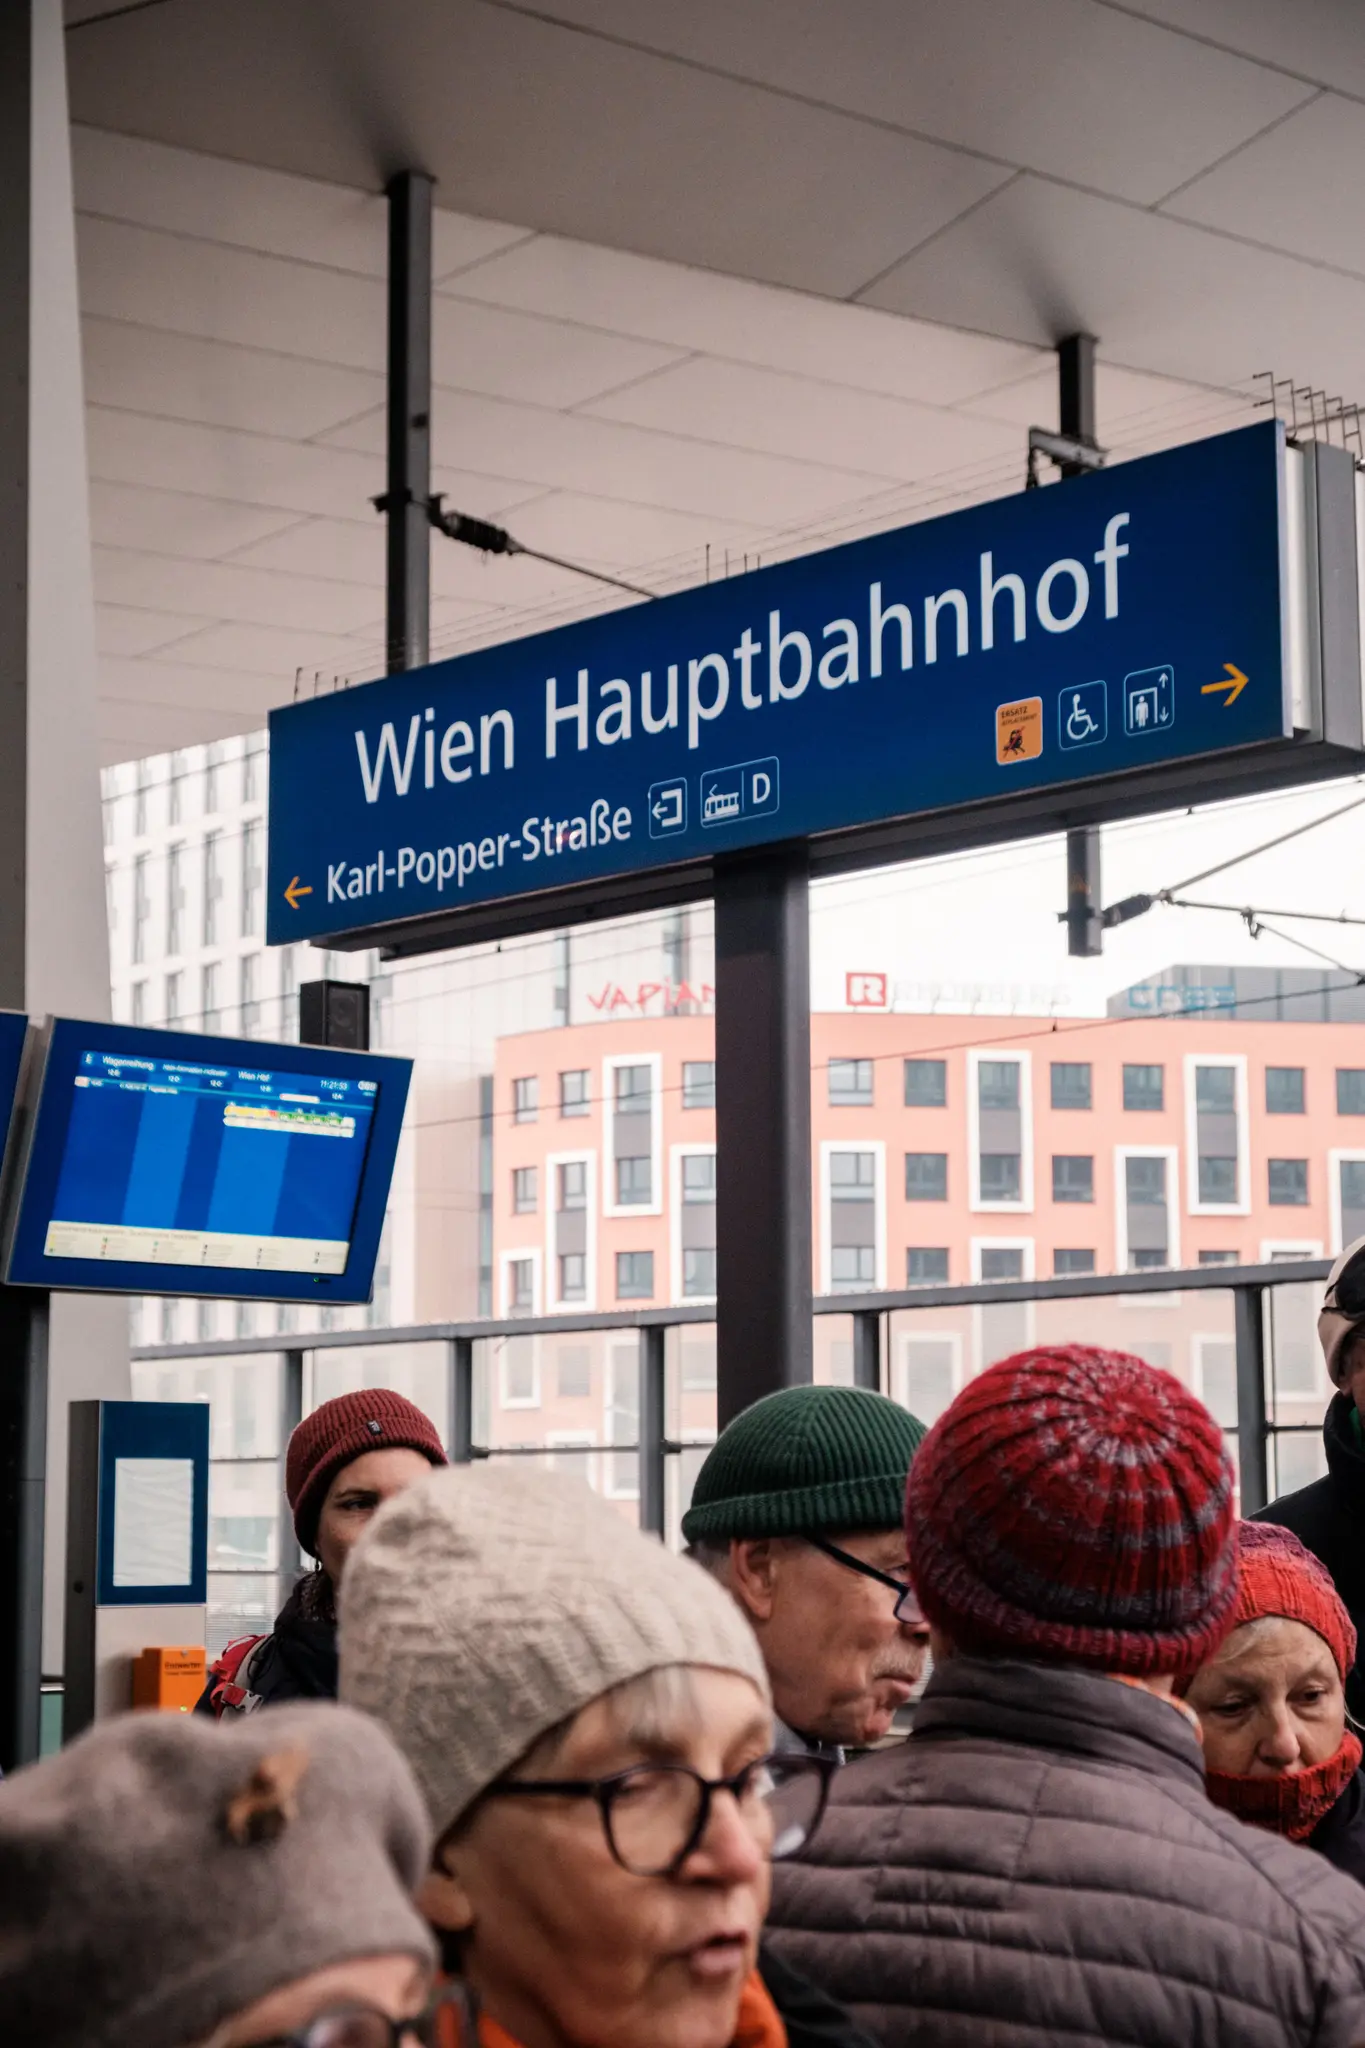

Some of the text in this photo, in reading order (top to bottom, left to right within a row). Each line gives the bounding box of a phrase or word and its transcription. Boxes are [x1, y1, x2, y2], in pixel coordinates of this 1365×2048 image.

[355, 513, 1130, 803] Wien Hauptbahnhof
[752, 773, 772, 804] D
[327, 799, 632, 902] Karl-Popper-Straße
